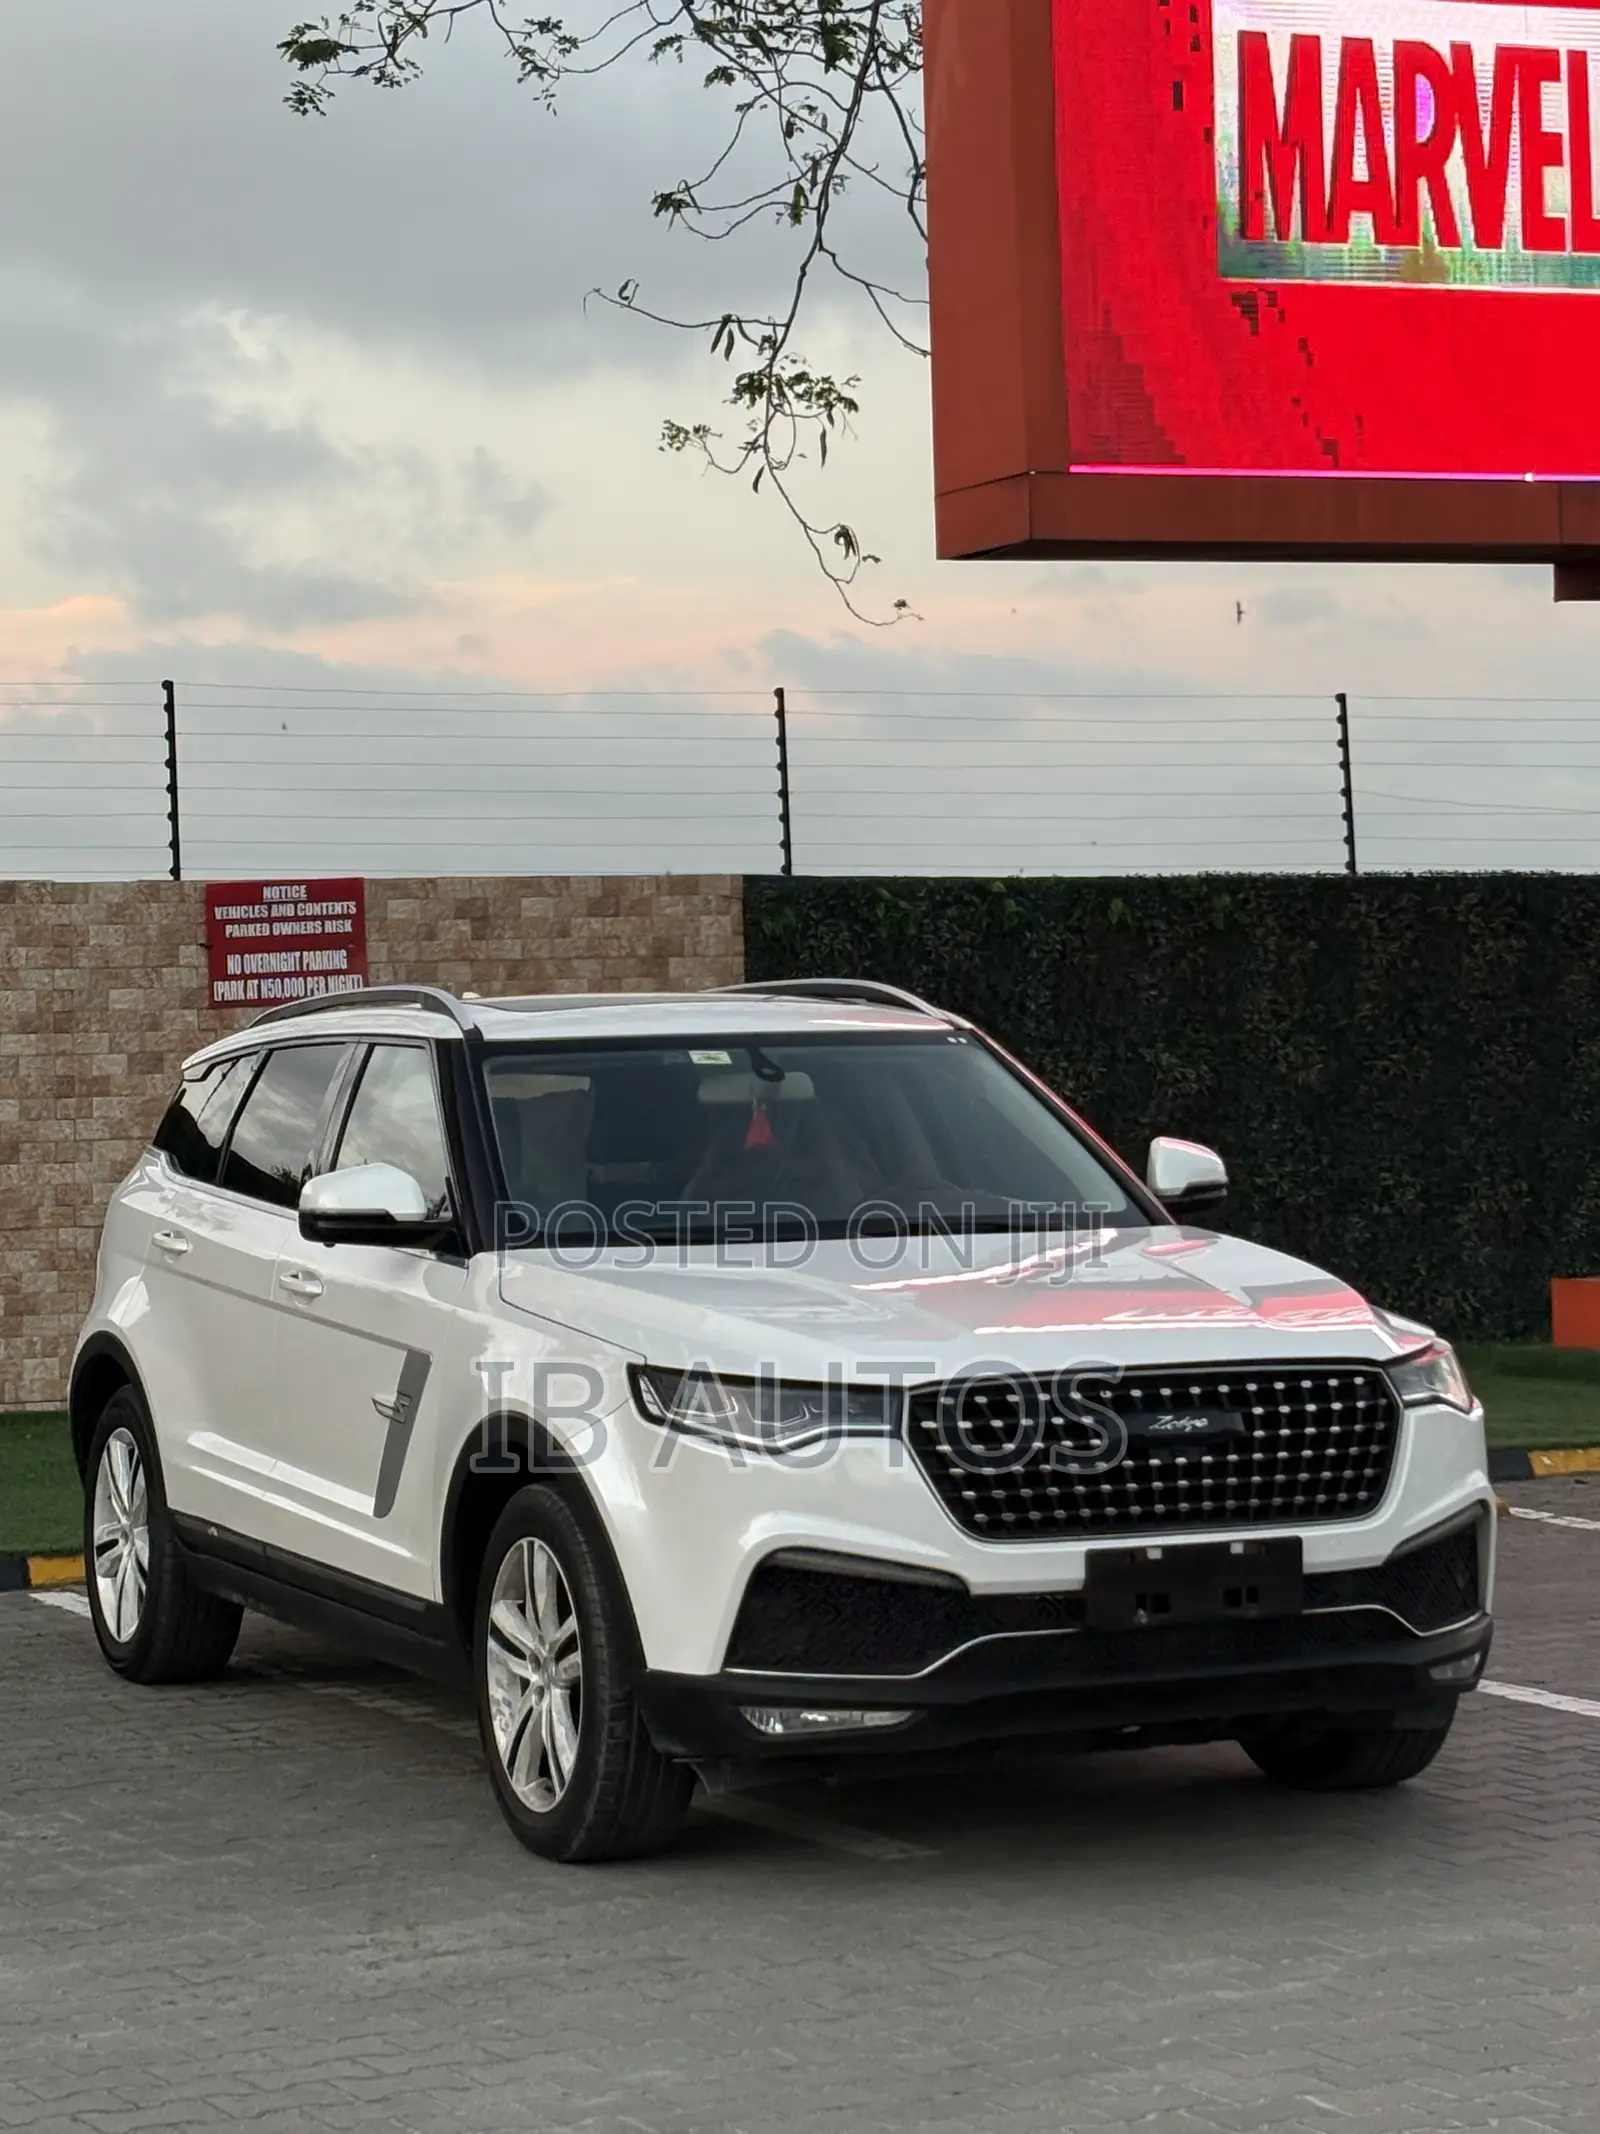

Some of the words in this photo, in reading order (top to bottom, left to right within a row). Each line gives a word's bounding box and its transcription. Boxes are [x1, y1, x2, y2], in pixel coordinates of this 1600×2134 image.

[1237, 30, 1600, 253] MARVEL
[263, 885, 307, 901] NOTICE
[214, 905, 268, 920] VEHICLES
[270, 904, 295, 918] AND
[297, 901, 356, 916] CONTENTS
[225, 922, 270, 938] PARKED
[272, 921, 322, 936] OWNERS
[324, 919, 353, 933] RISK
[227, 954, 242, 975] NO
[243, 951, 300, 975] OVERNIGHT
[303, 949, 347, 971] PARKING
[213, 980, 245, 1001] (PARK
[246, 978, 259, 999] AT
[307, 975, 327, 996] PER
